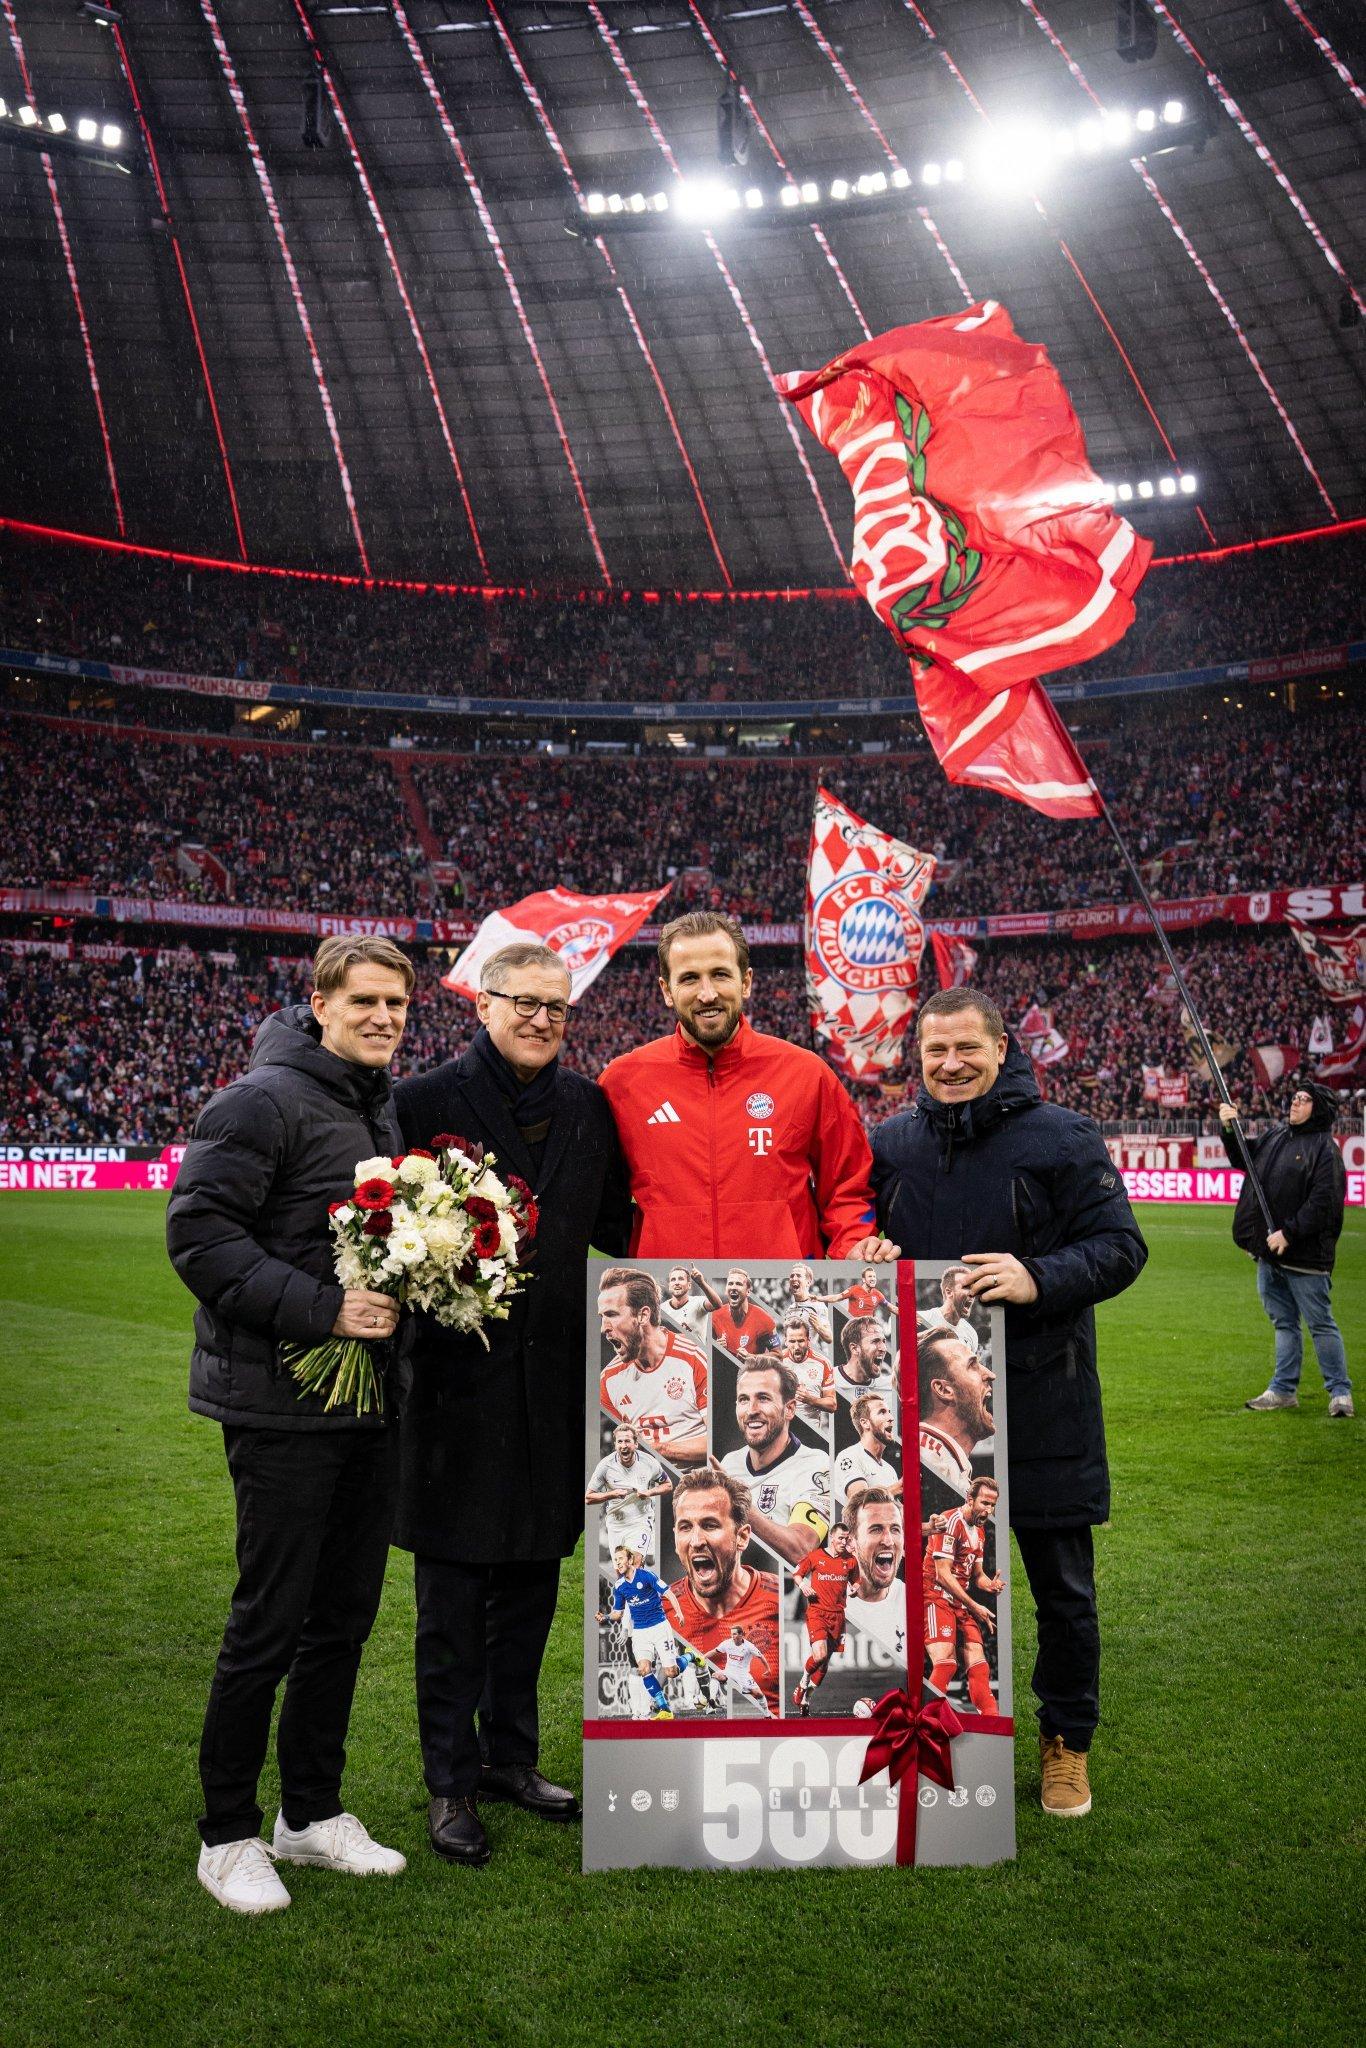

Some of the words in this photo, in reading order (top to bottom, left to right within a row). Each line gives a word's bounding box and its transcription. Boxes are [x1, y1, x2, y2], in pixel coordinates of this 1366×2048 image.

[831, 880, 864, 910] FC
[29, 1147, 126, 1163] STEHEN
[33, 1164, 96, 1188] NETZ
[1121, 1171, 1193, 1199] ESSER
[1197, 1172, 1225, 1199] IM
[768, 1785, 899, 1810] GOALS
